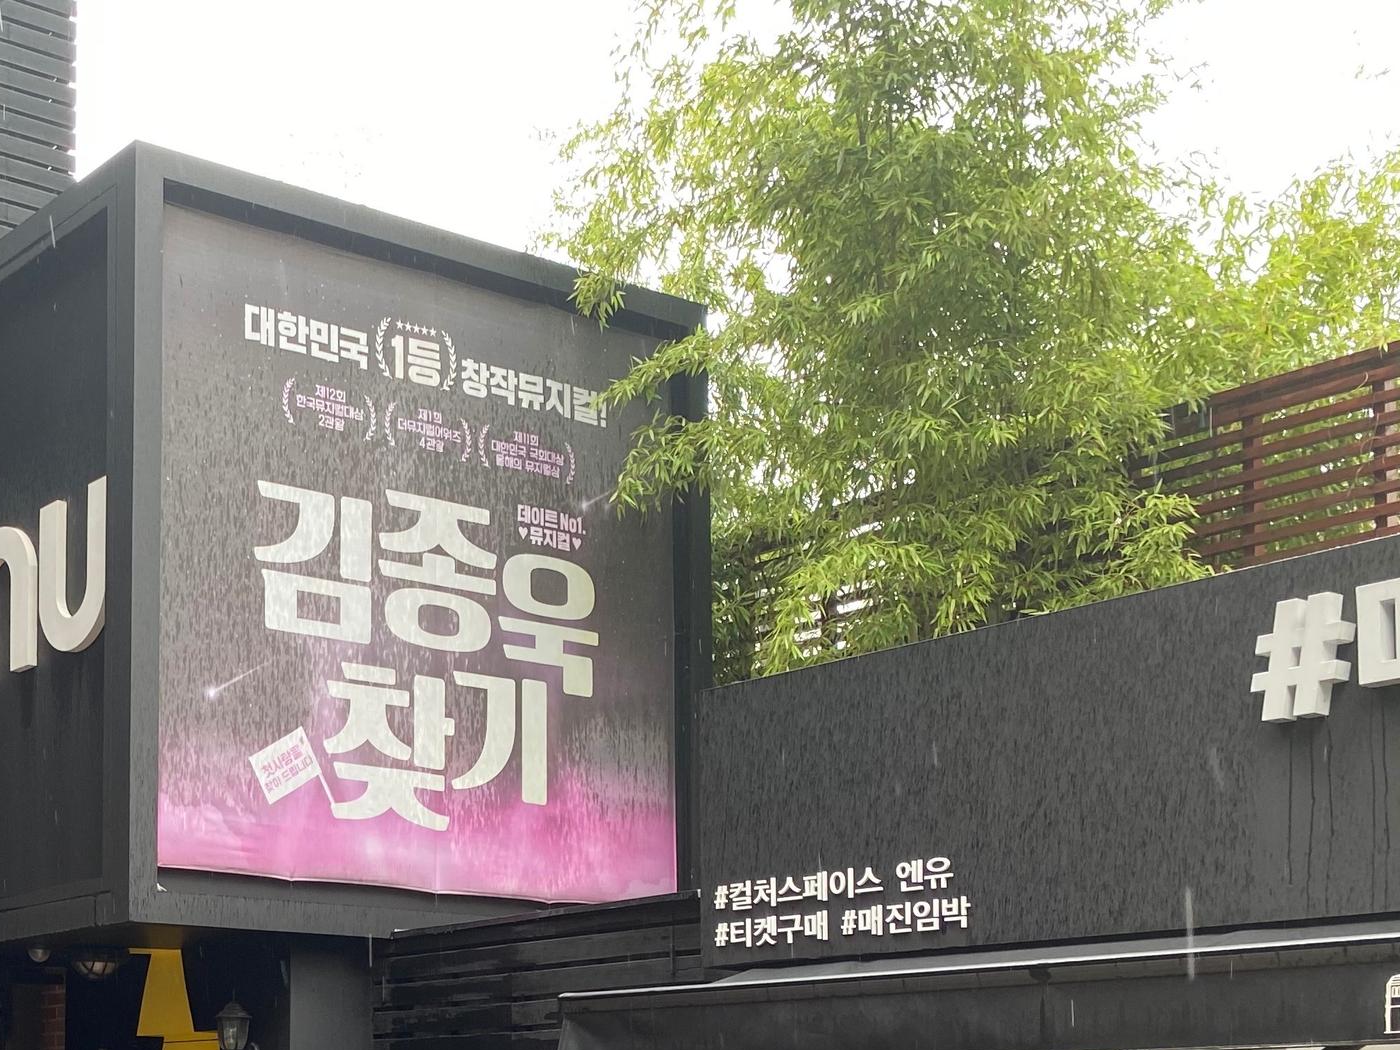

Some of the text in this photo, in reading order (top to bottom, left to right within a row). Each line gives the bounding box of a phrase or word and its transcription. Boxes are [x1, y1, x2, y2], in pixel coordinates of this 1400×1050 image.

[245, 303, 369, 371] 대한민국
[391, 334, 442, 388] 1등
[517, 504, 558, 529] 데이트
[530, 526, 571, 551] 뮤지컬
[254, 480, 600, 698] 김종욱
[323, 662, 548, 831] 찾기
[895, 856, 954, 893] 엔유
[714, 895, 972, 948] #티켓구매 #매진임박
